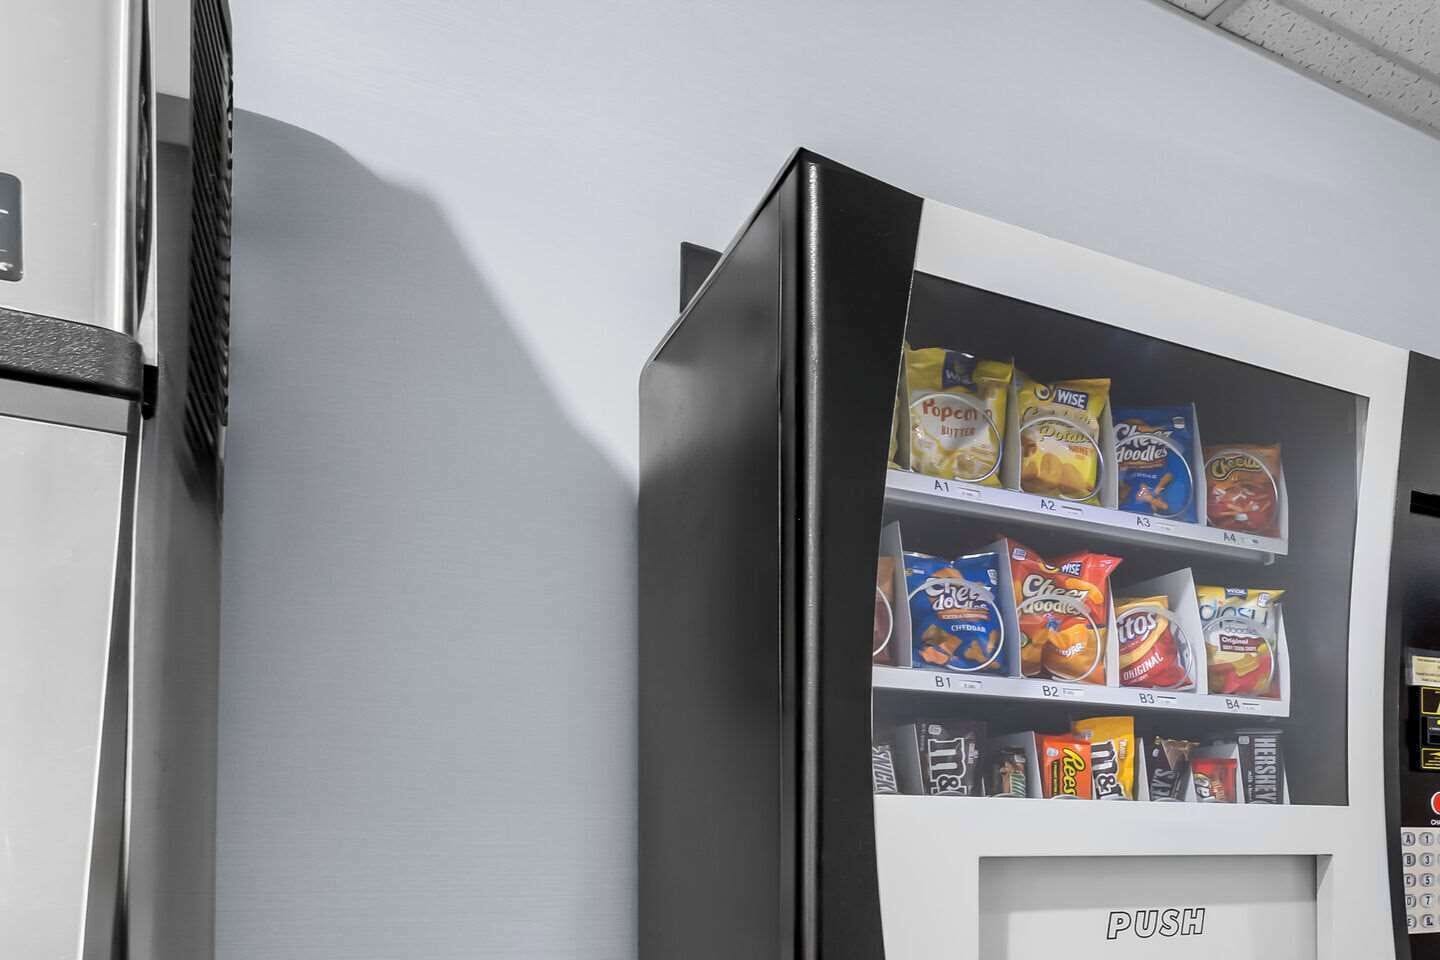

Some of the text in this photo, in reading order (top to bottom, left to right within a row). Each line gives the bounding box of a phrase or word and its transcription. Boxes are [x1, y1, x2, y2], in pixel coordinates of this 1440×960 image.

[1057, 388, 1086, 408] WISE
[934, 480, 949, 492] A1
[1040, 499, 1056, 510] A2
[1136, 517, 1150, 528] A3
[1223, 532, 1236, 542] A4
[1118, 611, 1157, 643] itos
[1123, 652, 1164, 681] ORIGINAL
[935, 675, 951, 688] B1
[1043, 685, 1059, 697] B2
[1139, 692, 1155, 704] B3
[1226, 698, 1240, 709] B4
[872, 749, 898, 794] SNICK
[1254, 738, 1277, 803] HERSHEY
[1107, 908, 1205, 940] PUSH
